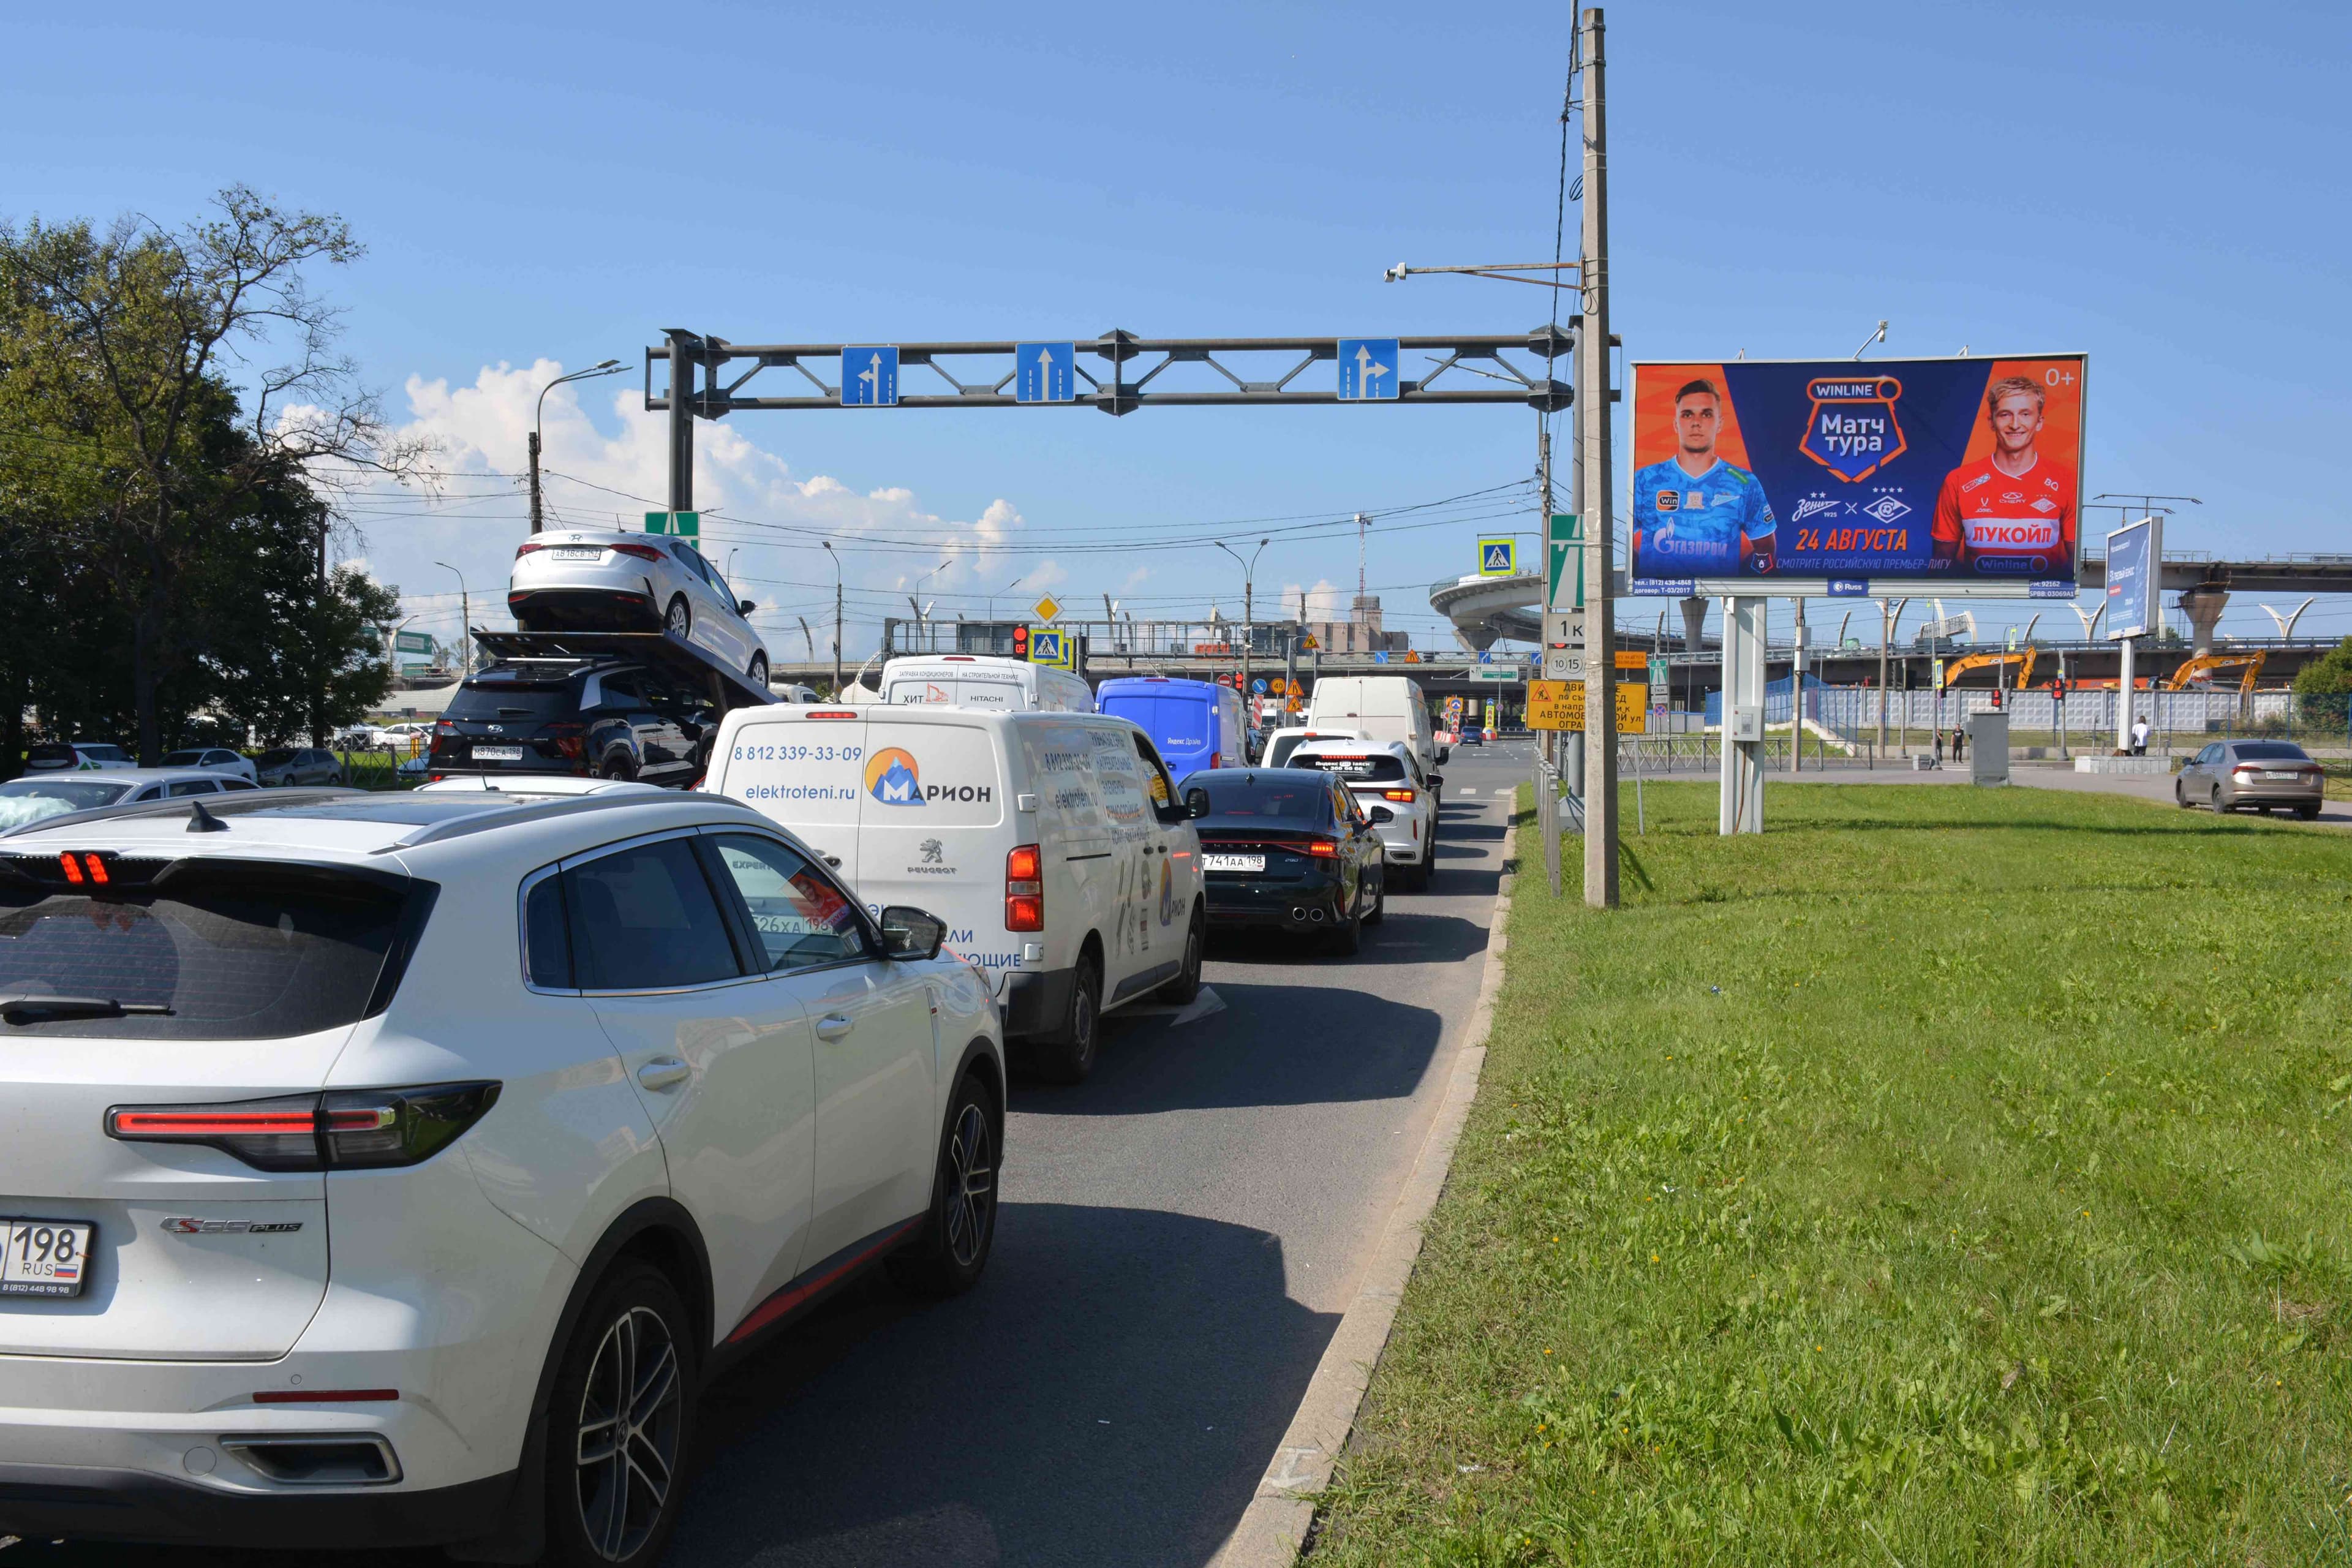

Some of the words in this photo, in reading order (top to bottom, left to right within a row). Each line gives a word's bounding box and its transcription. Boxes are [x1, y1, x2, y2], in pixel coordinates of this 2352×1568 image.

[2046, 368, 2075, 386] 0+
[1816, 385, 1872, 396] WINLINE
[1822, 414, 1884, 434] Матч
[1825, 435, 1882, 456] тура
[1795, 528, 1819, 551] 24
[1824, 528, 1907, 551] АВГУСТА
[1972, 524, 2051, 543] ЛУКОЙЛ
[1675, 540, 1728, 558] ГАЗПРОМ
[1776, 558, 1822, 570] СМОТРИТЕ
[1823, 557, 1881, 570] РОССИЙСКУЮ
[1883, 558, 1951, 570] ПРЕМЬЕР-ЛИГУ
[1981, 559, 2027, 570] Winline
[1561, 620, 1567, 636] 1
[1573, 625, 1583, 636] к
[1016, 644, 1026, 654] 02
[1568, 659, 1579, 669] 15
[903, 695, 924, 704] ХИТ
[1185, 737, 1201, 745] Драйв
[474, 747, 507, 756] М870СА
[734, 747, 742, 760] 8
[747, 747, 774, 760] 812
[778, 746, 862, 761] 339-33-09
[745, 785, 855, 800] elektroteni.ru
[883, 780, 991, 802] МАРИОН
[1055, 788, 1098, 810] elektroteni.ru
[1202, 855, 1243, 866] Т741АА
[1246, 856, 1262, 864] 198
[251, 1223, 300, 1232] PLUS
[14, 1226, 75, 1263] 198
[22, 1262, 53, 1276] RUS
